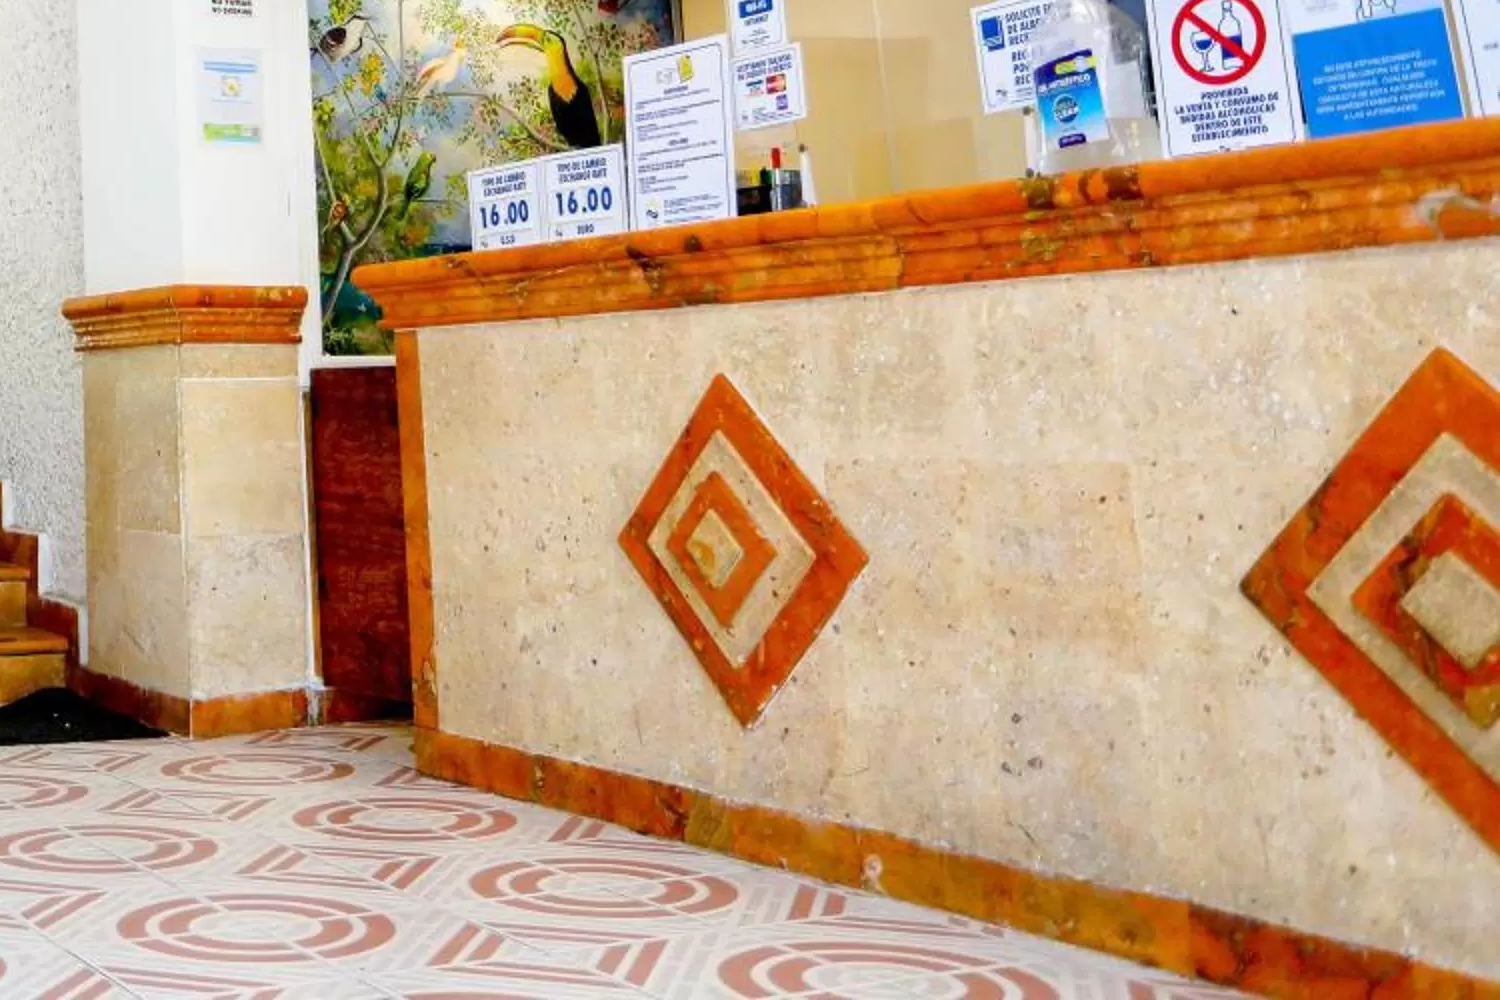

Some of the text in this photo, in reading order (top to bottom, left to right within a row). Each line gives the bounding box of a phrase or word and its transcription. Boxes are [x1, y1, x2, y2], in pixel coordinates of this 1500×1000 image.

[1201, 86, 1248, 100] PROHIBIDA
[1174, 91, 1279, 115] LA VENTA Y CONSUMO DE
[1180, 111, 1216, 124] BEBIDAS
[1194, 115, 1262, 132] DENTRO DE ESTE
[1192, 124, 1269, 142] ESTABLECIMIENTO
[559, 167, 607, 184] EXCHANGE RATE
[556, 186, 613, 217] 16.00
[480, 200, 529, 229] 16.00
